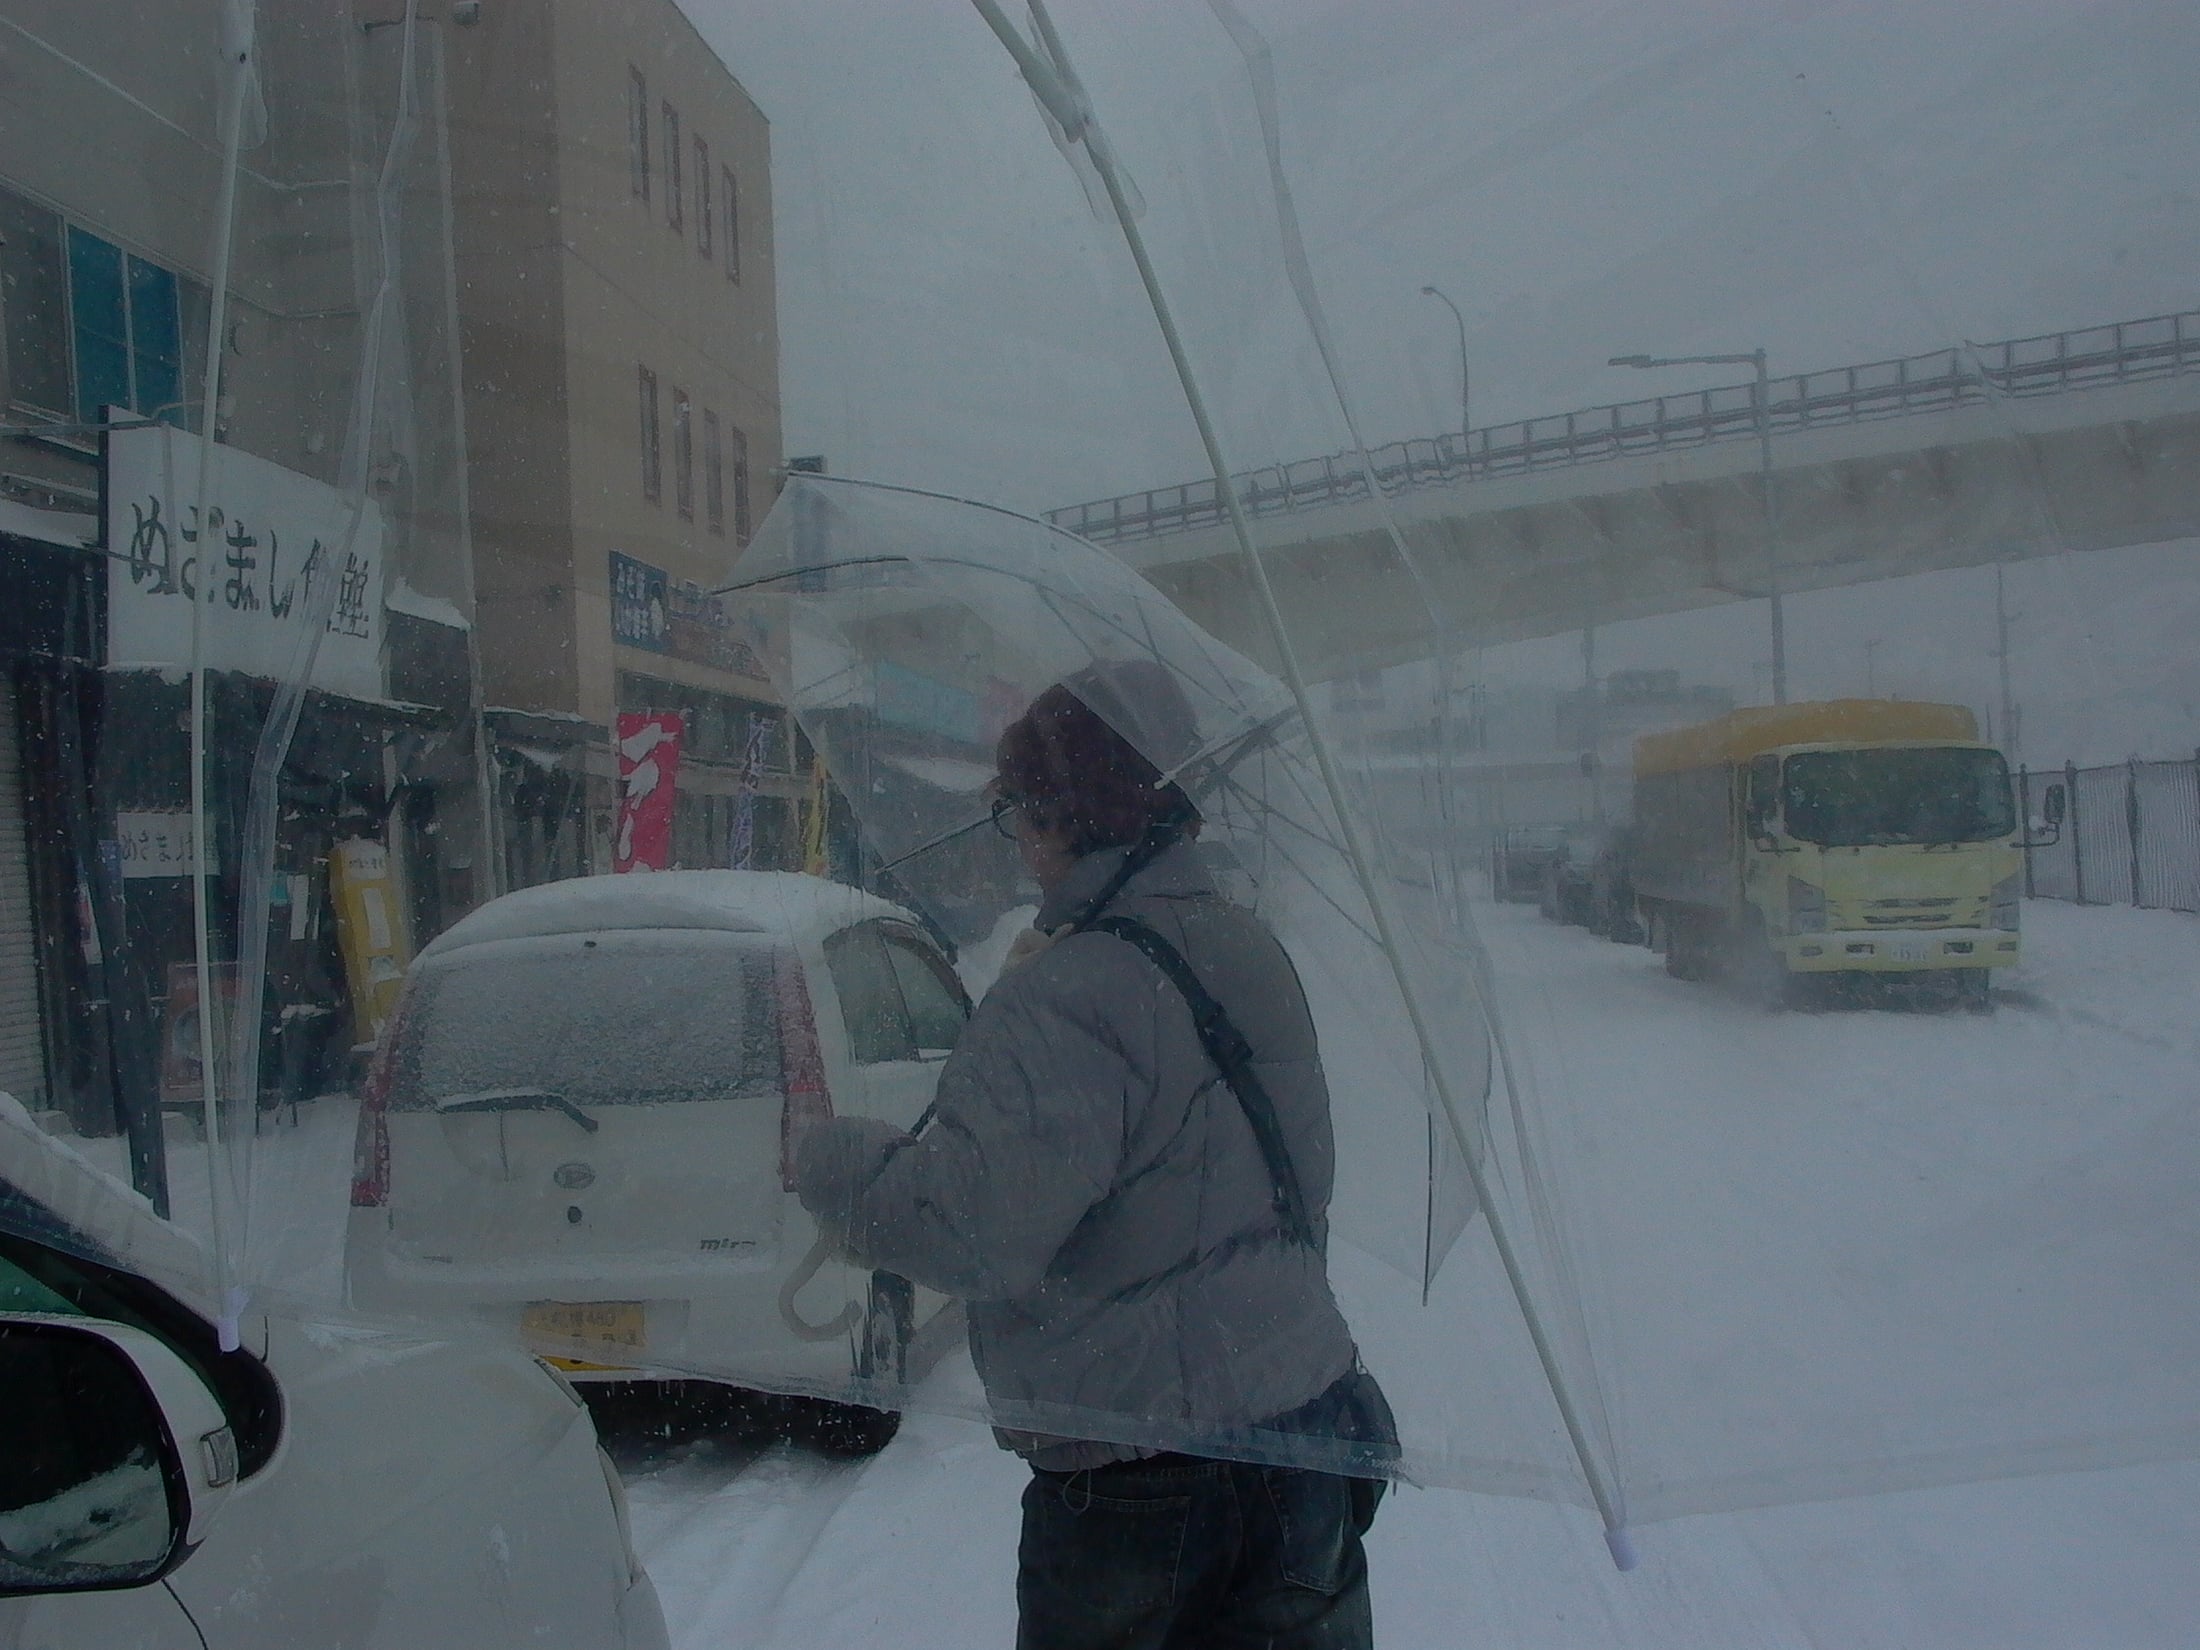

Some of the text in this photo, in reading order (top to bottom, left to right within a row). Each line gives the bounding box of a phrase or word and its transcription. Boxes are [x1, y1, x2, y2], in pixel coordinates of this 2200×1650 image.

[130, 495, 369, 639] めざまし
[700, 1237, 757, 1251] mir
